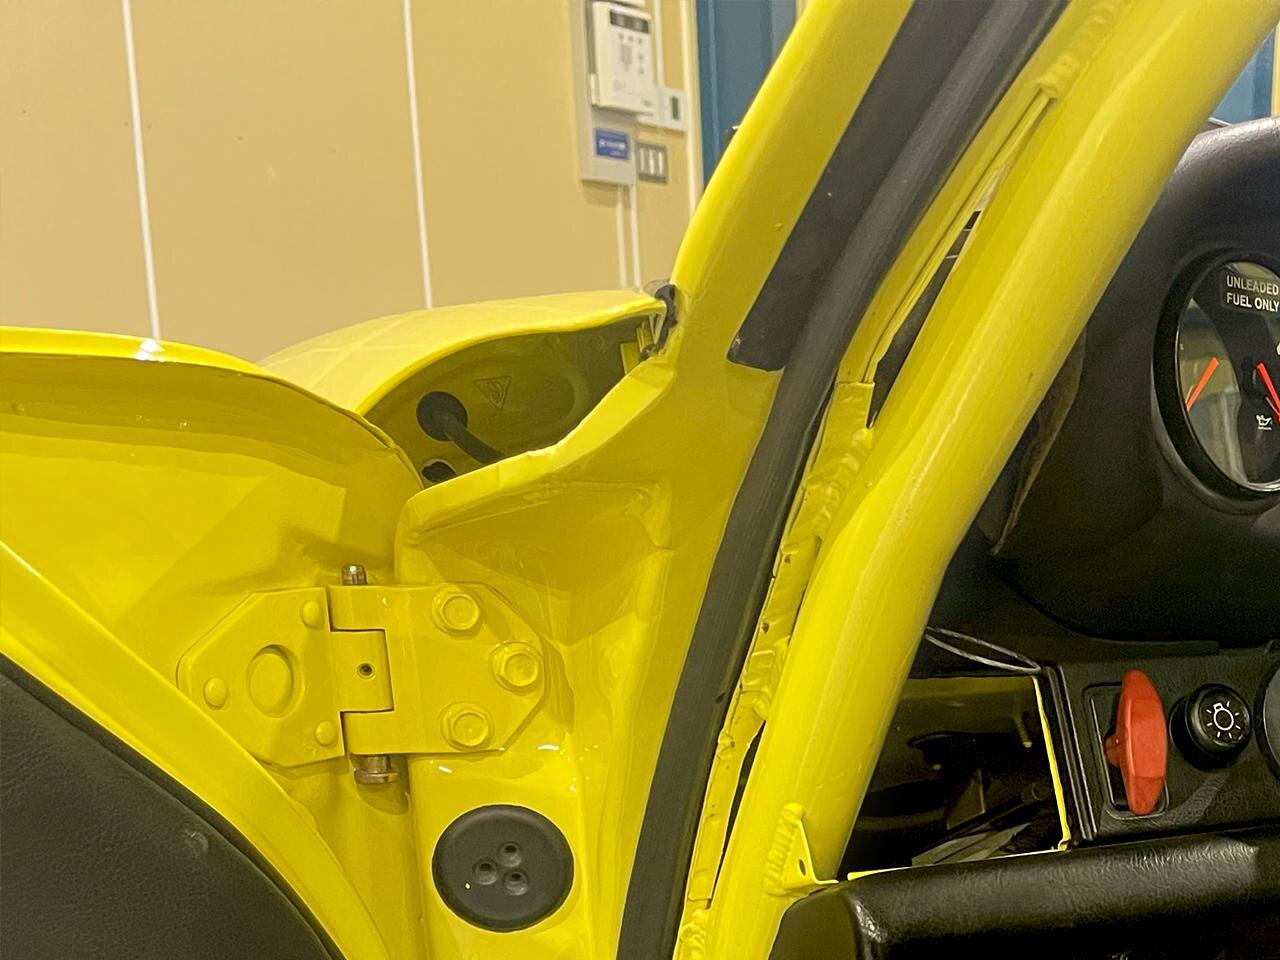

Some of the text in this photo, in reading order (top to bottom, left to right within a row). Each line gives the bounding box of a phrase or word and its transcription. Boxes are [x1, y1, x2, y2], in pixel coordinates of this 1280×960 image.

[1226, 274, 1279, 296] UNLEADED
[1226, 292, 1280, 313] FUEL ONLY
